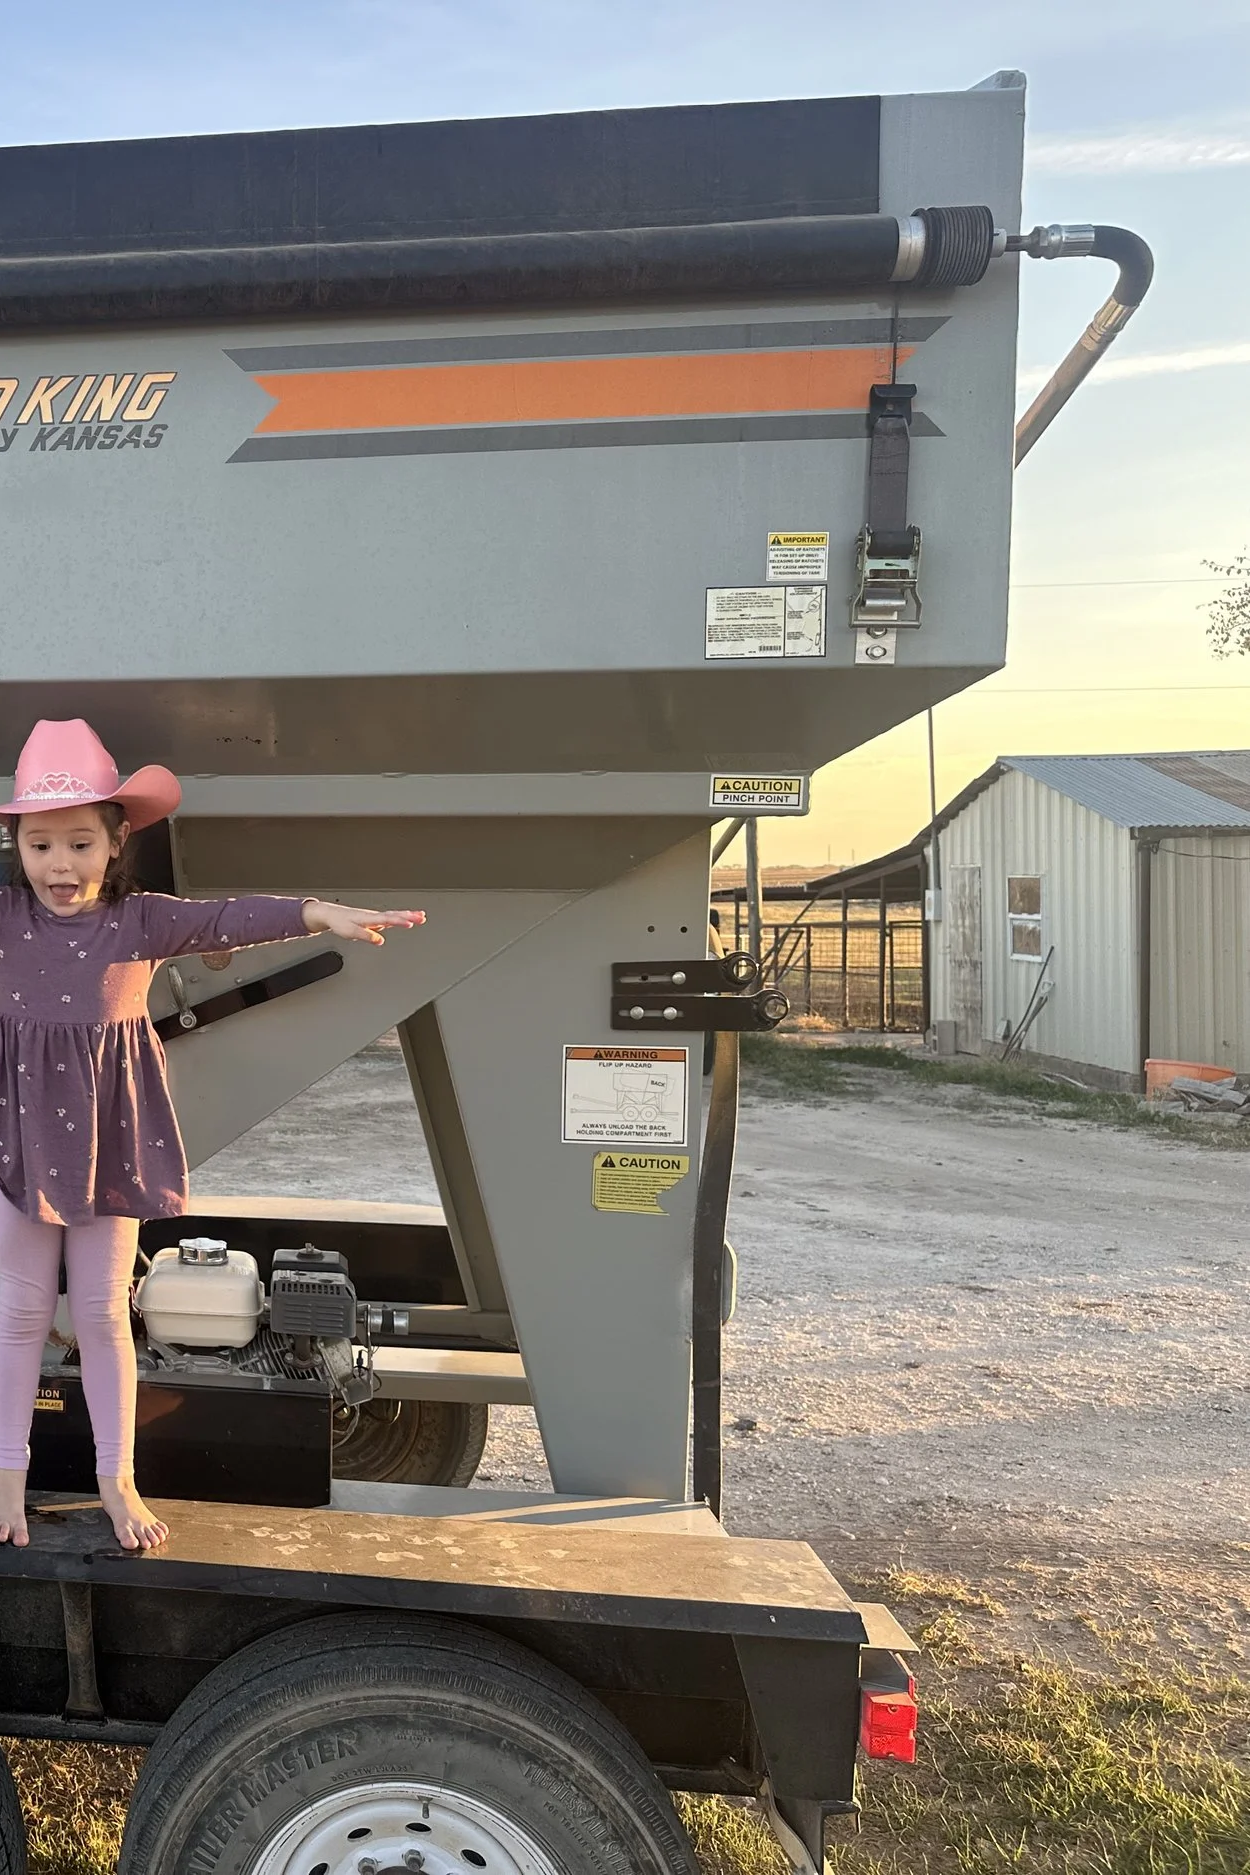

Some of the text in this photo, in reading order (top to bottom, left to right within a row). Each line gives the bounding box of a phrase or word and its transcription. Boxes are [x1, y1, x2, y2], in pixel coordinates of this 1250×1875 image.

[15, 370, 179, 426] KING
[29, 423, 169, 452] KANSAS
[732, 780, 793, 791] CAUTION
[723, 794, 790, 803] PINCH POINT
[604, 1050, 658, 1059] WARNING
[619, 1157, 681, 1170] CAUTION
[36, 1389, 60, 1399] TION
[236, 1727, 360, 1809] MASTER
[543, 1800, 559, 1817] FOR
[560, 1816, 589, 1848] TRAILER
